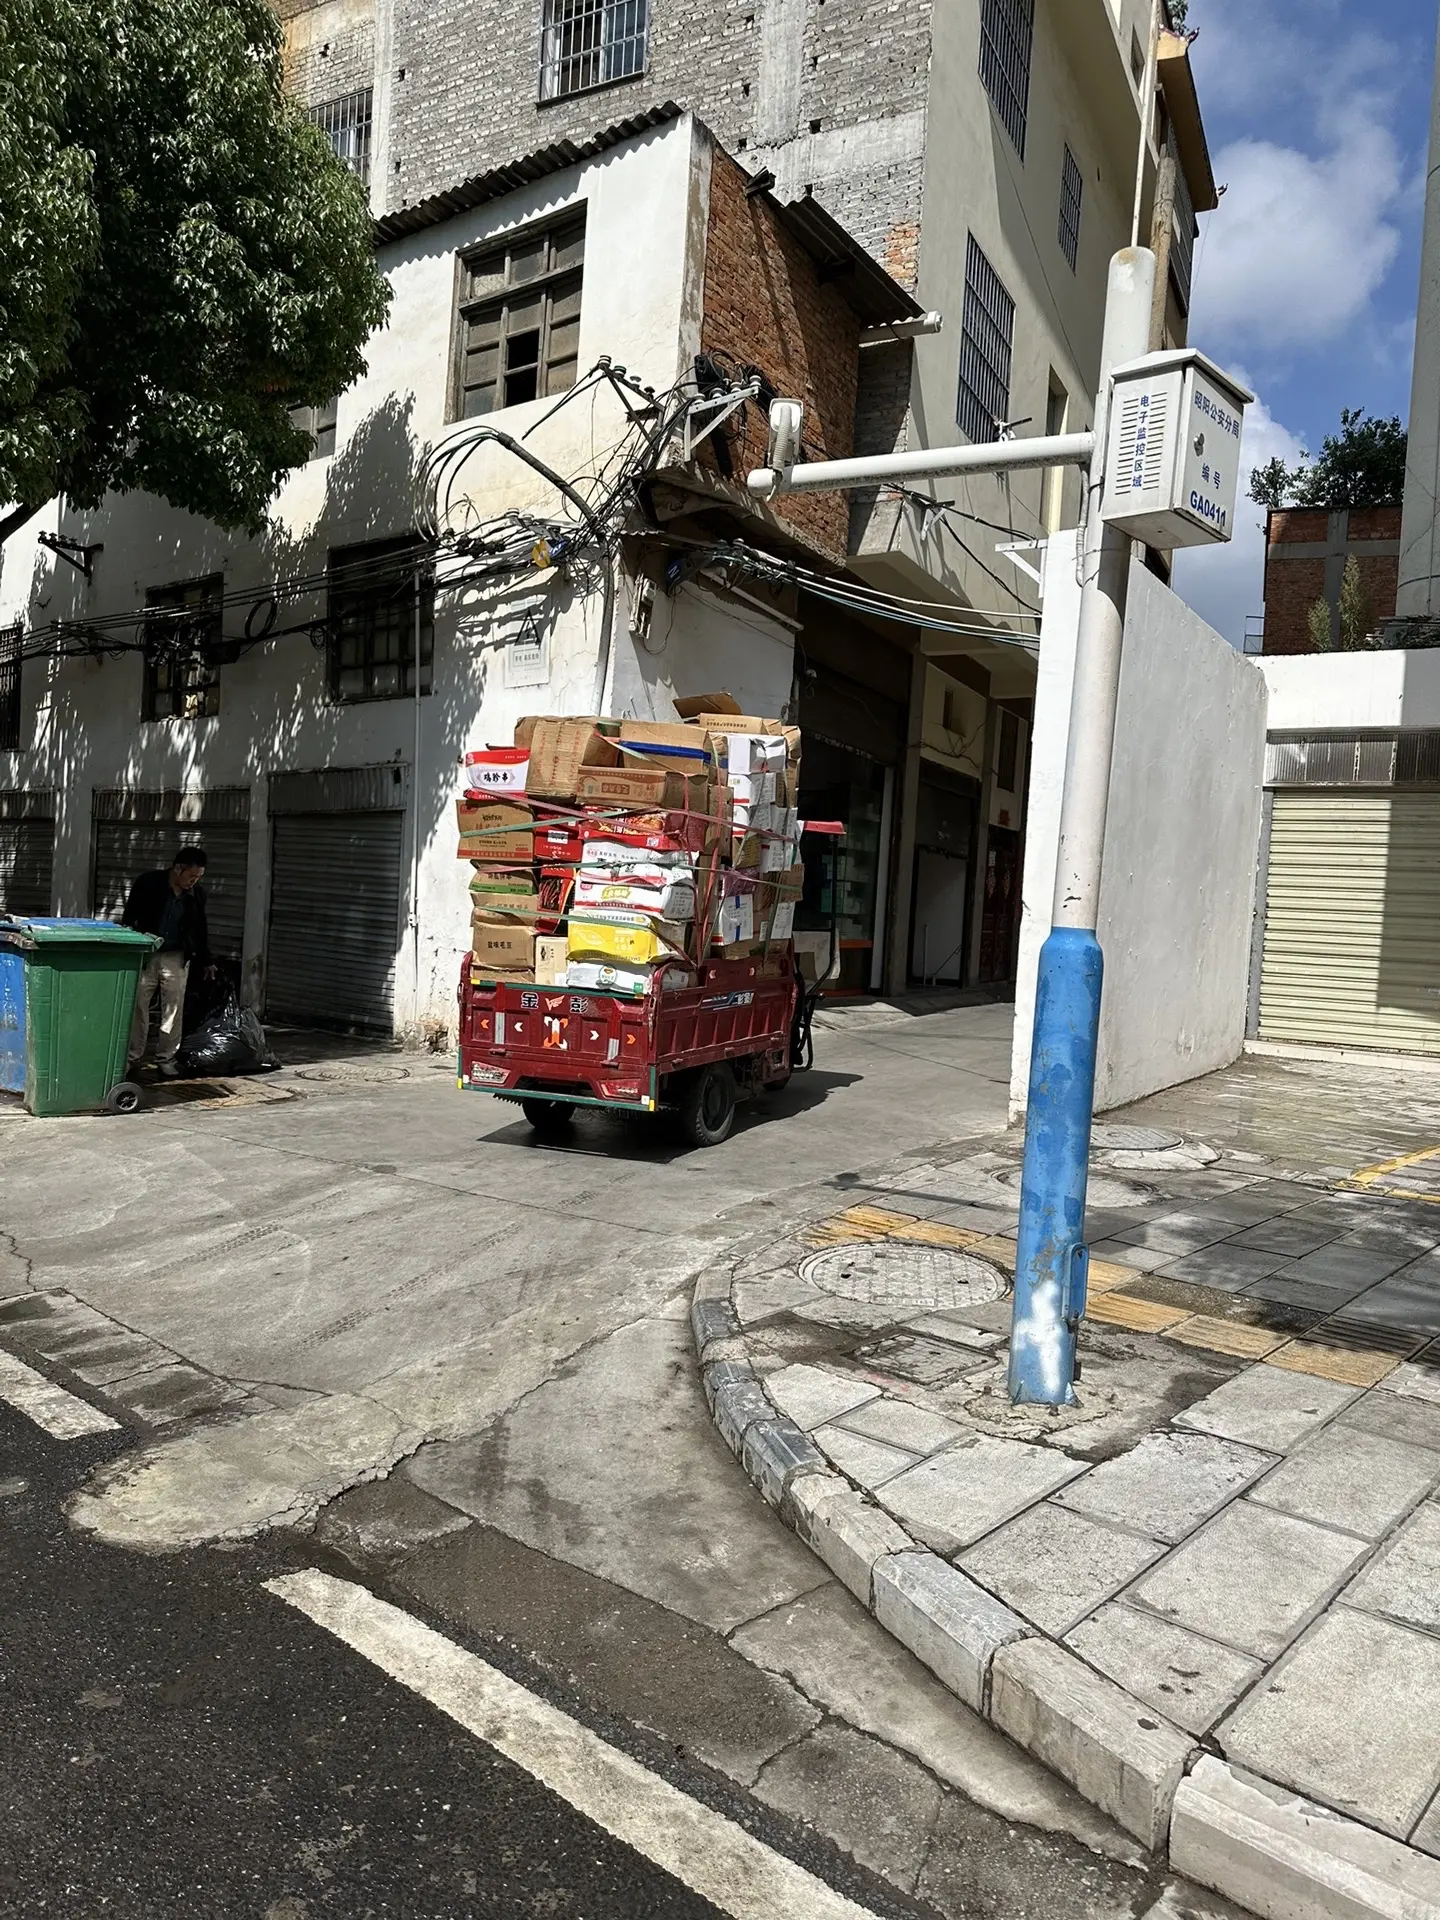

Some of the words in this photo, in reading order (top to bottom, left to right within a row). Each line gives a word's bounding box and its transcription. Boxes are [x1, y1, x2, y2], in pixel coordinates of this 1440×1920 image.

[1194, 390, 1240, 438] 昭阳公安分局
[1132, 395, 1150, 488] 电子监控区域
[1190, 490, 1226, 527] GA0411
